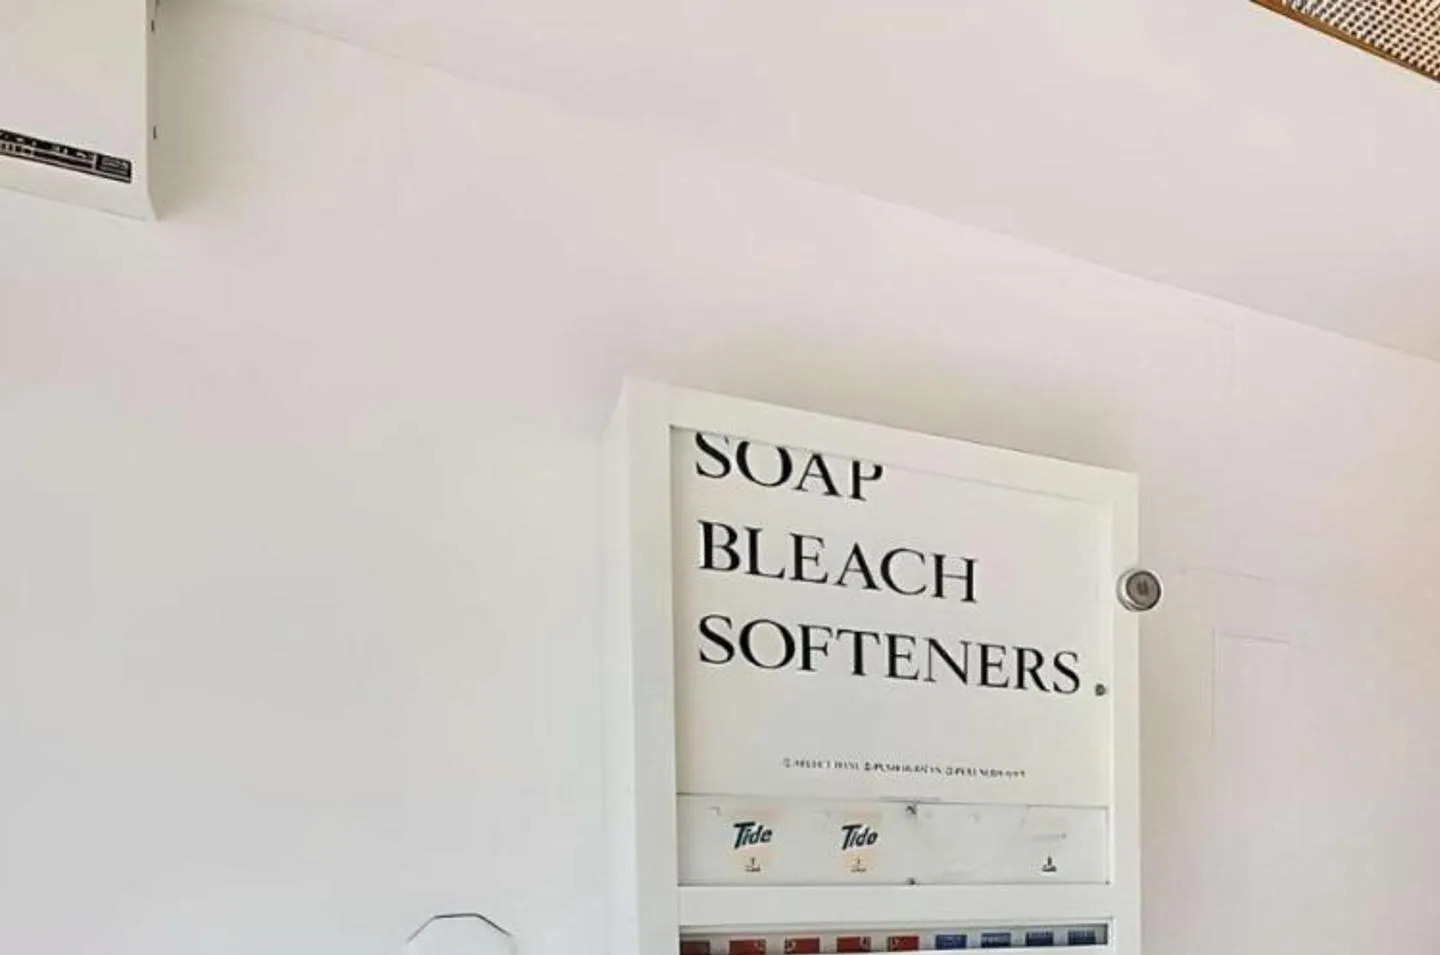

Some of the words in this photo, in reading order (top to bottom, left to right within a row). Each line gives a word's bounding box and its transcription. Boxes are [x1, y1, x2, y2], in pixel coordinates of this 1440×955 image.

[695, 431, 883, 500] SOAP
[697, 519, 978, 602] BLEACH
[699, 613, 1080, 695] SOFTENERS
[733, 821, 773, 850] Tide
